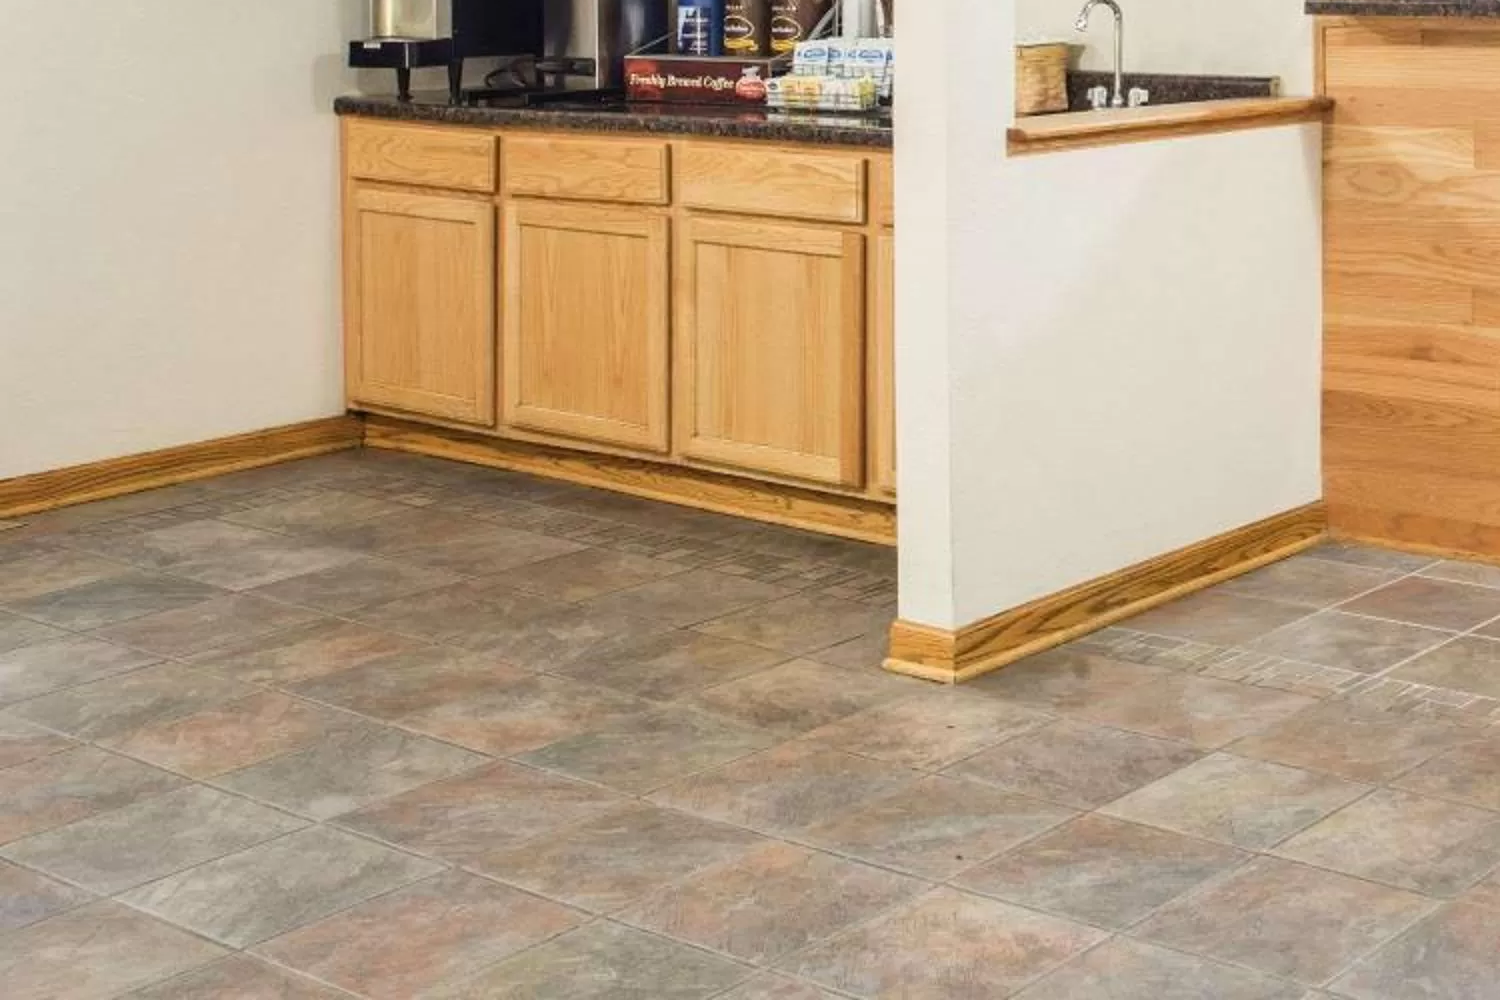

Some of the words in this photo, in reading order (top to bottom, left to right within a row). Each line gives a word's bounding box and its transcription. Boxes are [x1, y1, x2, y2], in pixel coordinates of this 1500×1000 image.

[629, 73, 665, 89] Freshly
[667, 74, 702, 88] Brewed
[703, 75, 734, 91] Coffee
